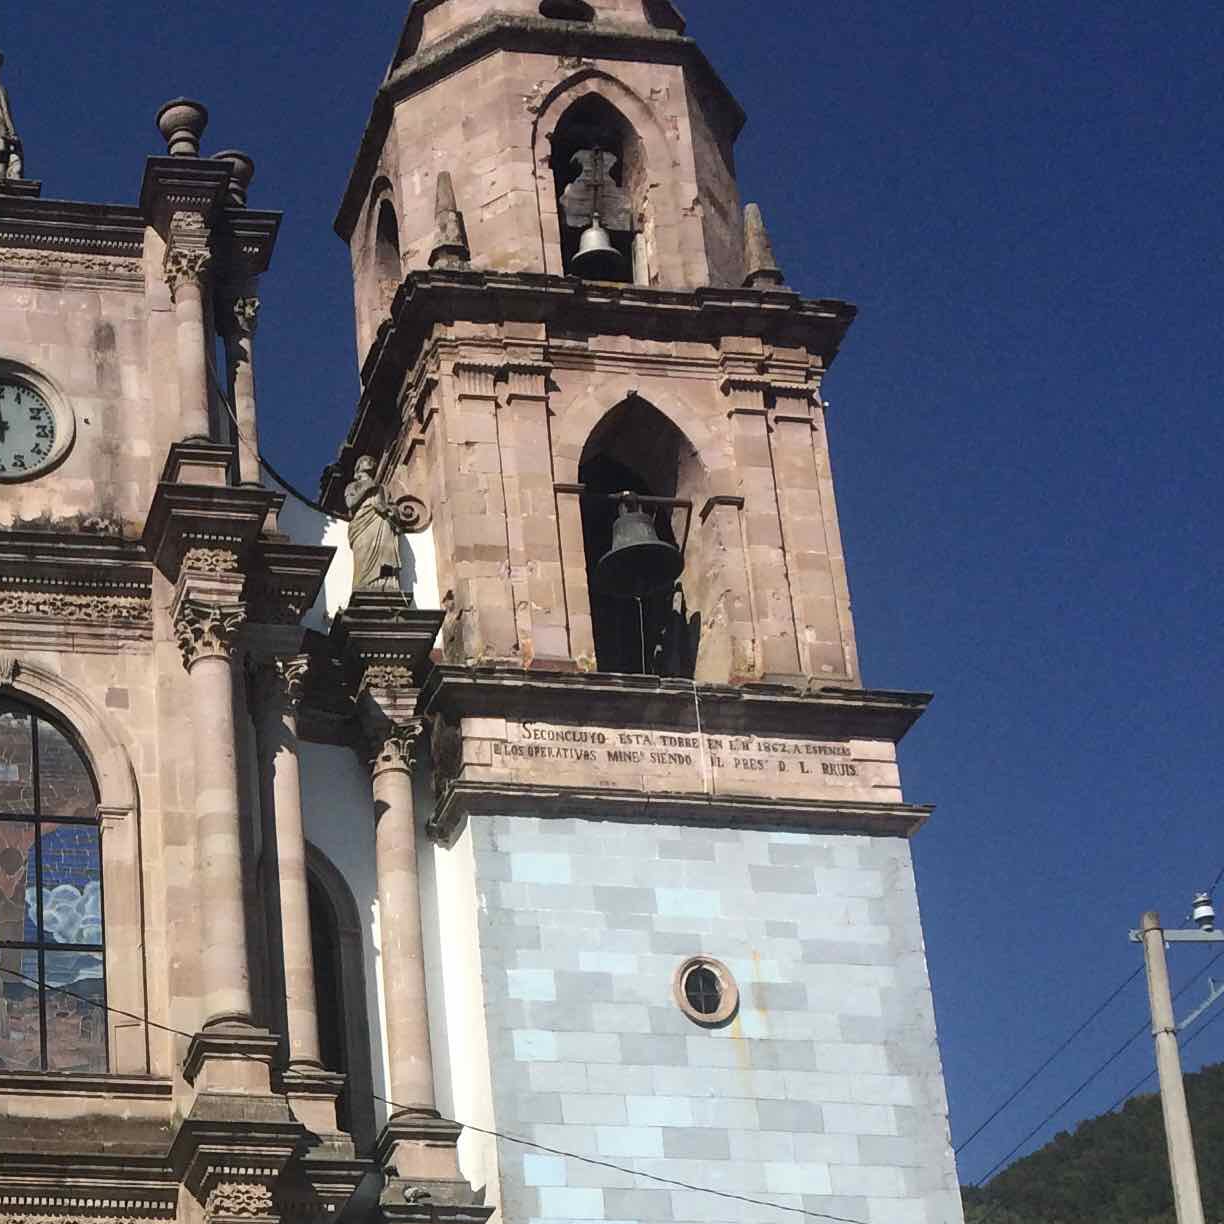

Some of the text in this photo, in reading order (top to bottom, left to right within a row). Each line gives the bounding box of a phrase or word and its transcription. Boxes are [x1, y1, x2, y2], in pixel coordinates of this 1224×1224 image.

[29, 407, 41, 421] 2
[36, 425, 49, 438] 3
[12, 454, 26, 468] 5
[649, 751, 692, 766] SIENDO
